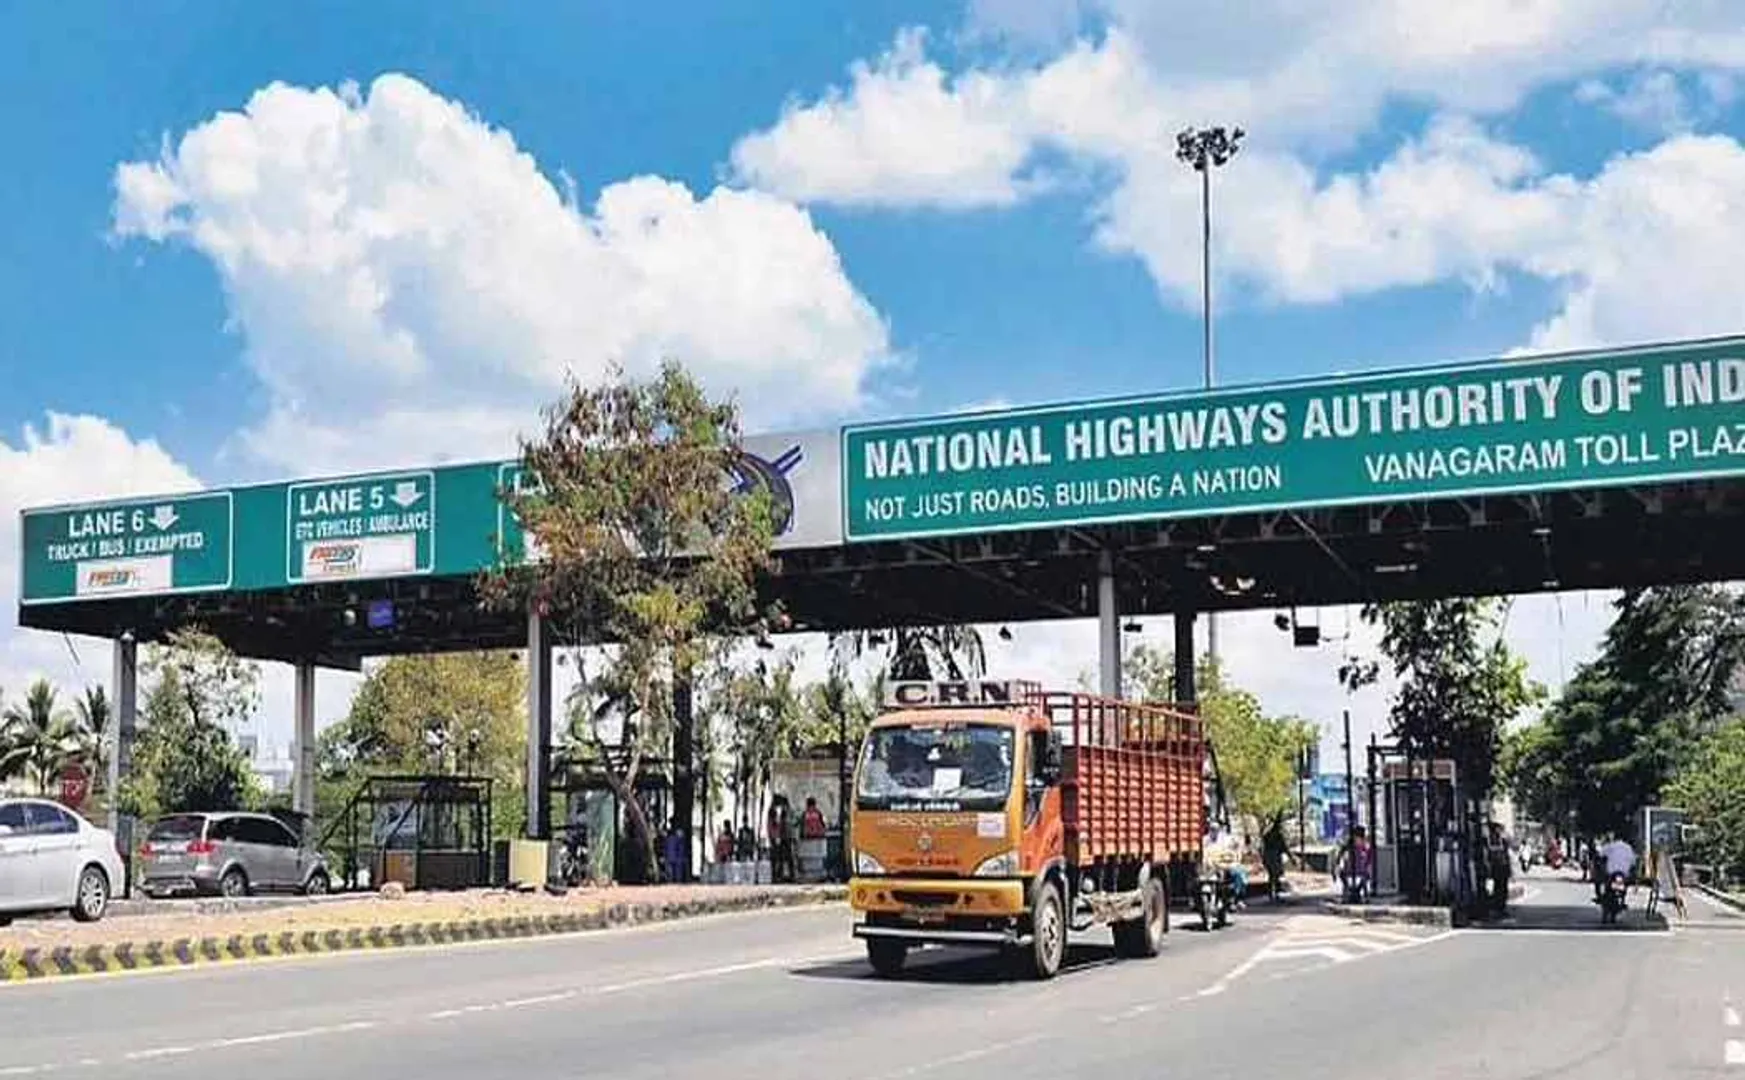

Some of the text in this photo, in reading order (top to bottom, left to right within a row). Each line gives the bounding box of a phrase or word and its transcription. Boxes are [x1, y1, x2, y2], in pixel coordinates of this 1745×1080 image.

[864, 358, 1745, 480] NATIONAL HIGHWAYS AUTHORITY OF IND
[1365, 439, 1567, 483] VANAGARAM
[1575, 432, 1660, 465] TOLL
[300, 486, 384, 515] LANE 5
[865, 496, 904, 521] NOT
[912, 491, 964, 518] JUST
[1057, 474, 1162, 507] BUILDING
[1169, 474, 1187, 497] A
[1193, 465, 1281, 495] NATION
[69, 509, 145, 538] LANE 6
[48, 542, 89, 560] TRUCK
[99, 538, 125, 556] BUS
[135, 531, 204, 553] EXEMPTED
